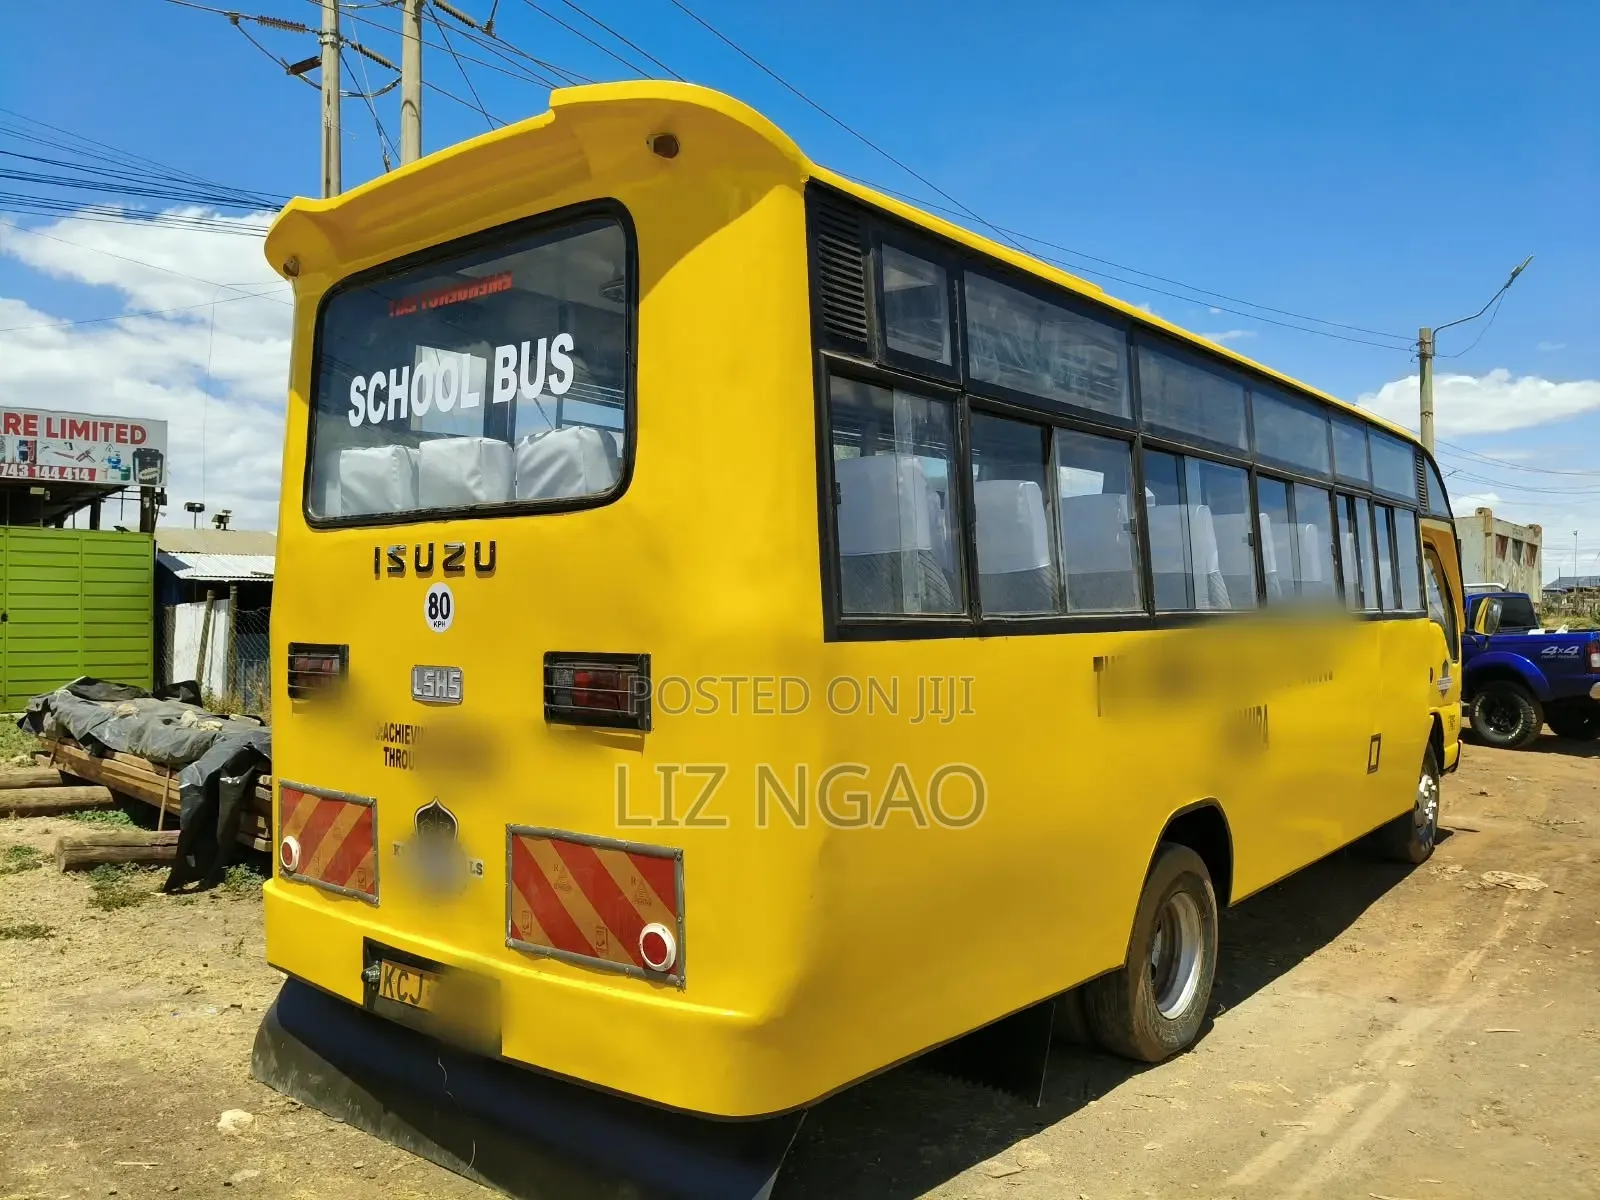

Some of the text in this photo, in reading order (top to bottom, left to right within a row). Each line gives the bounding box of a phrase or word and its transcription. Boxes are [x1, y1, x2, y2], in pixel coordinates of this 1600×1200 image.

[348, 332, 575, 427] SCHOOL BUS
[0, 412, 147, 445] RE LIMITED
[33, 465, 60, 479] 144
[63, 468, 90, 481] 414
[374, 541, 497, 574] ISUZU
[428, 592, 451, 619] 80
[433, 620, 446, 628] KPH
[1541, 646, 1580, 655] 4x4
[382, 964, 424, 1004] KCJ
